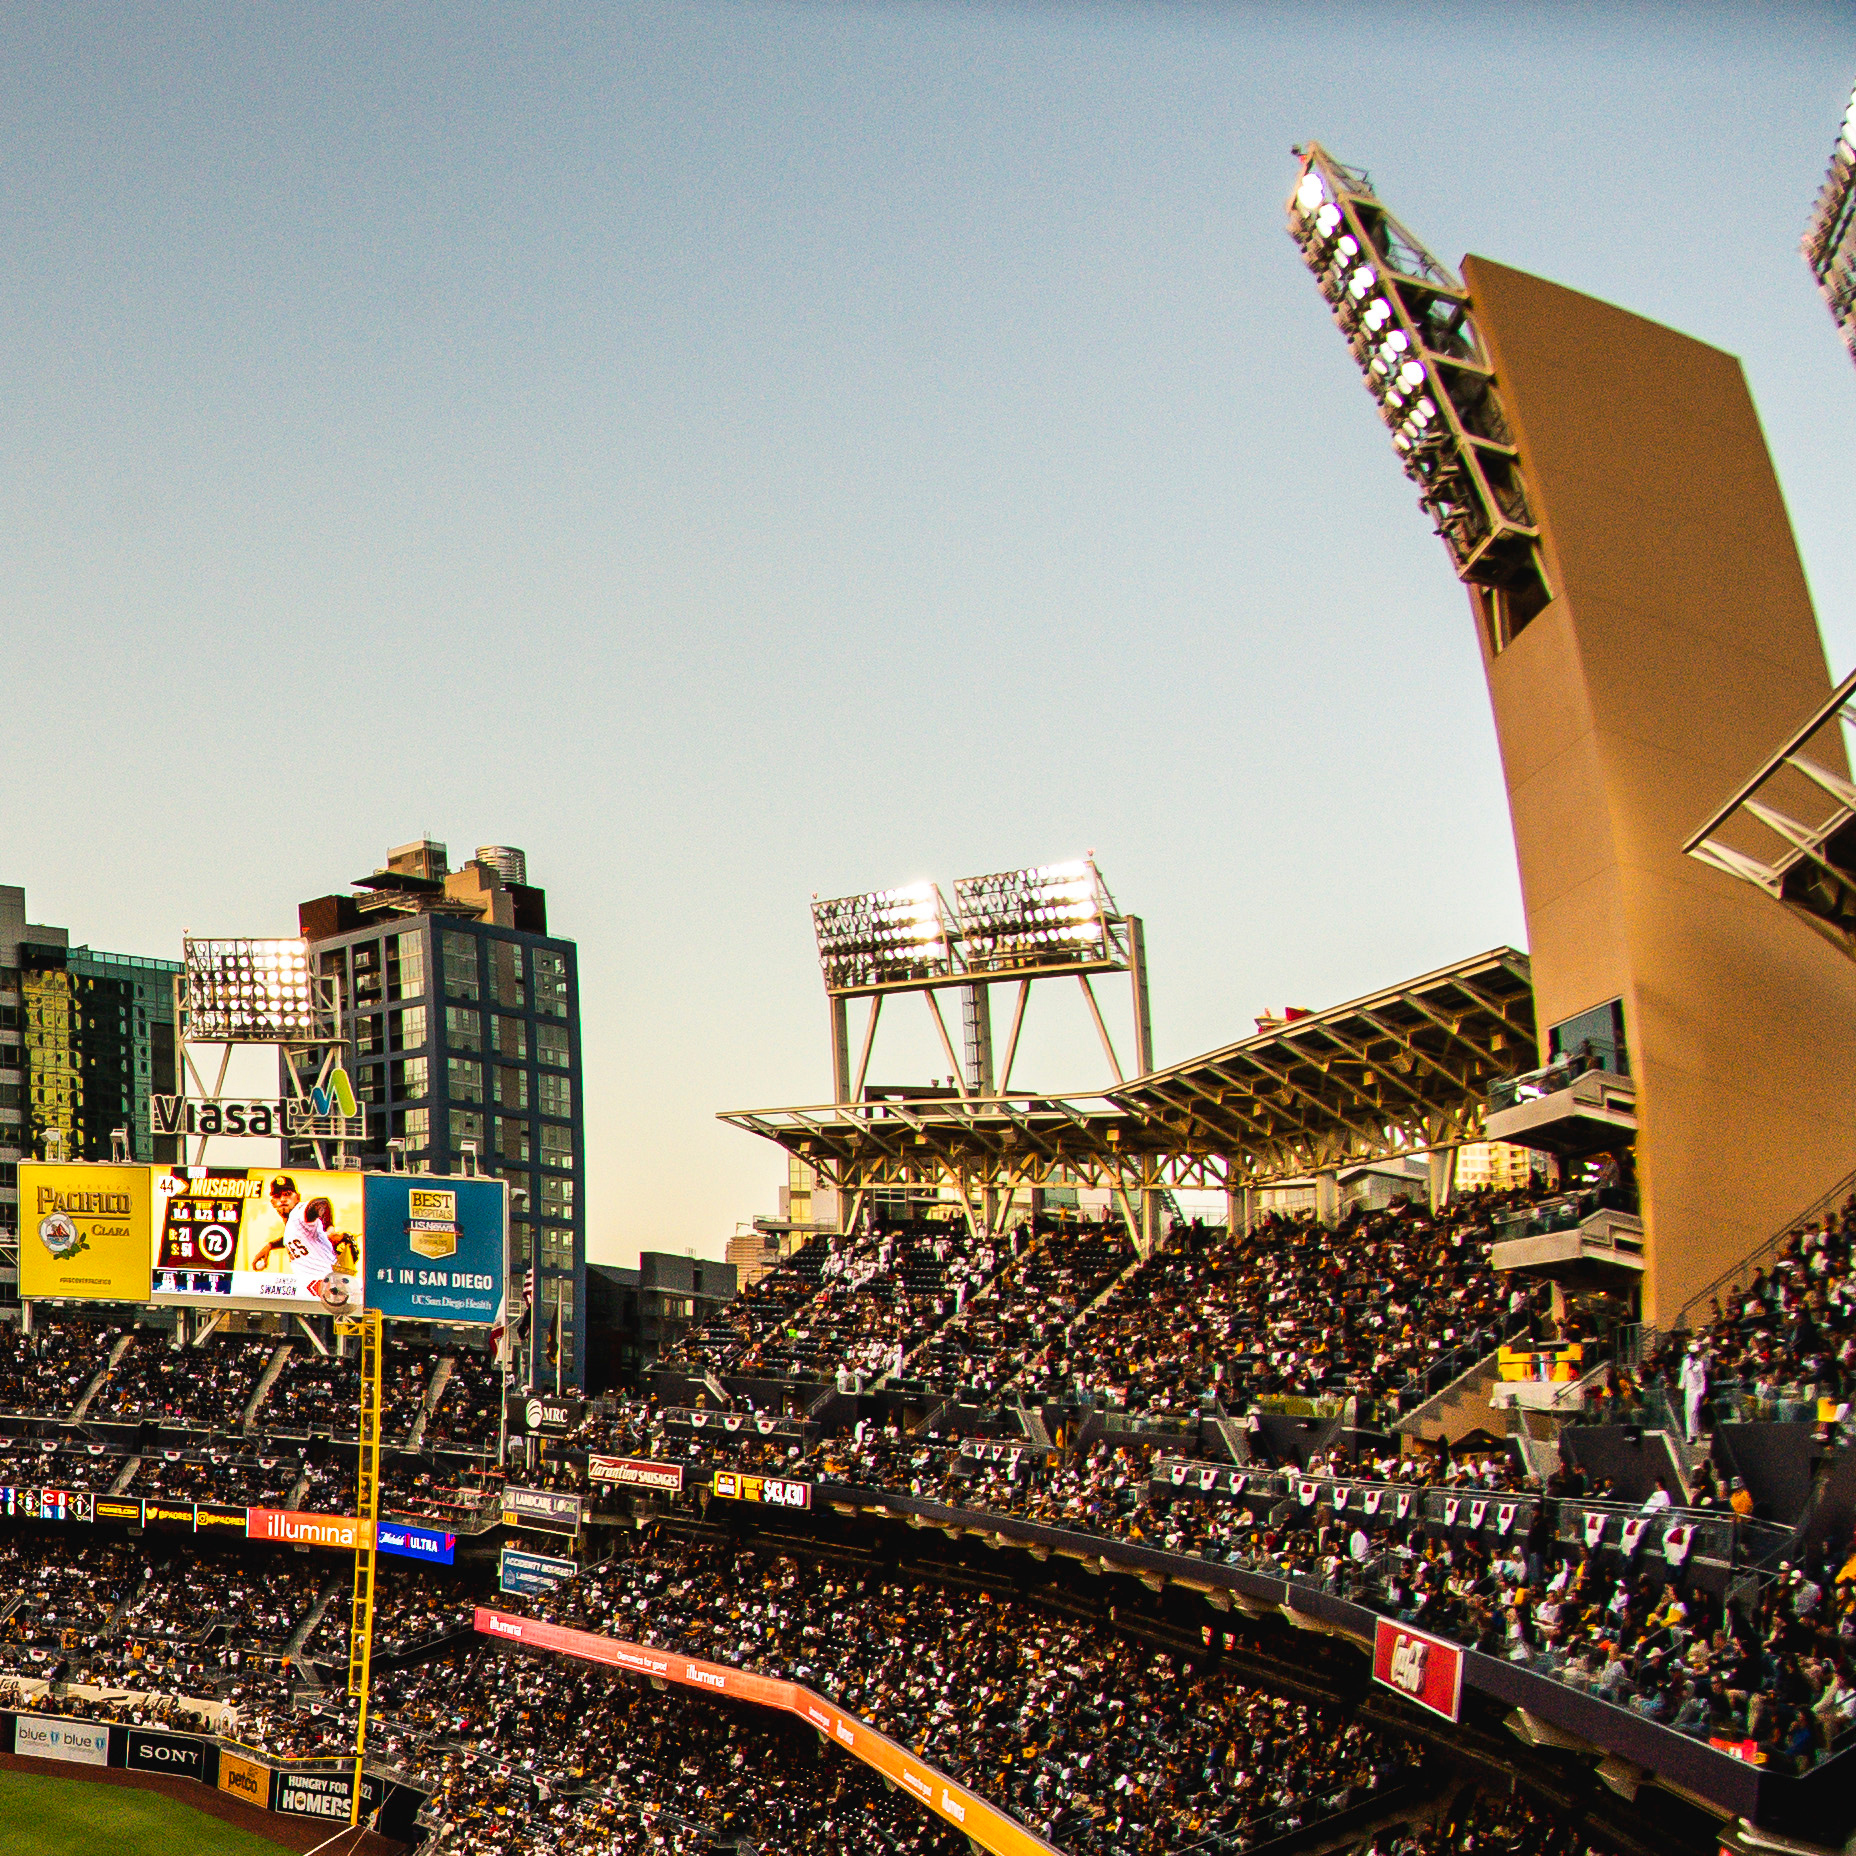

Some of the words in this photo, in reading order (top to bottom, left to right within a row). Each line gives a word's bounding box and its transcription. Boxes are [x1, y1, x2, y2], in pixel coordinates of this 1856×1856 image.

[154, 1095, 296, 1135] Viasat
[160, 1179, 173, 1192] 44
[190, 1179, 262, 1197] MUSGROVE
[37, 1186, 132, 1214] PACIFICO
[413, 1193, 452, 1208] BEST
[413, 1208, 453, 1219] HOSPITALS
[91, 1224, 130, 1236] CLARA
[208, 1235, 222, 1251] 72
[377, 1268, 393, 1283] #1
[400, 1270, 413, 1284] IN
[419, 1271, 447, 1286] SAN
[452, 1274, 492, 1290] DIEGO
[260, 1286, 297, 1296] SWANSON
[412, 1294, 424, 1304] UC
[426, 1296, 441, 1305] San
[442, 1297, 465, 1309] Diego
[466, 1298, 492, 1310] Health
[543, 1406, 568, 1423] MRC
[590, 1458, 637, 1482] Tarantino
[638, 1469, 678, 1487] SAUSAGES
[763, 1480, 804, 1507] $43,430
[158, 1510, 192, 1522] @PADRES
[207, 1515, 245, 1526] @PADRES
[268, 1515, 352, 1544] illumina
[490, 1616, 522, 1637] illumina
[686, 1664, 725, 1687] illumina
[19, 1726, 47, 1743] blue
[63, 1733, 91, 1747] blue
[139, 1744, 197, 1765] SONY
[228, 1770, 258, 1794] petco
[288, 1775, 327, 1791] HUNGRY
[329, 1780, 348, 1795] FOR
